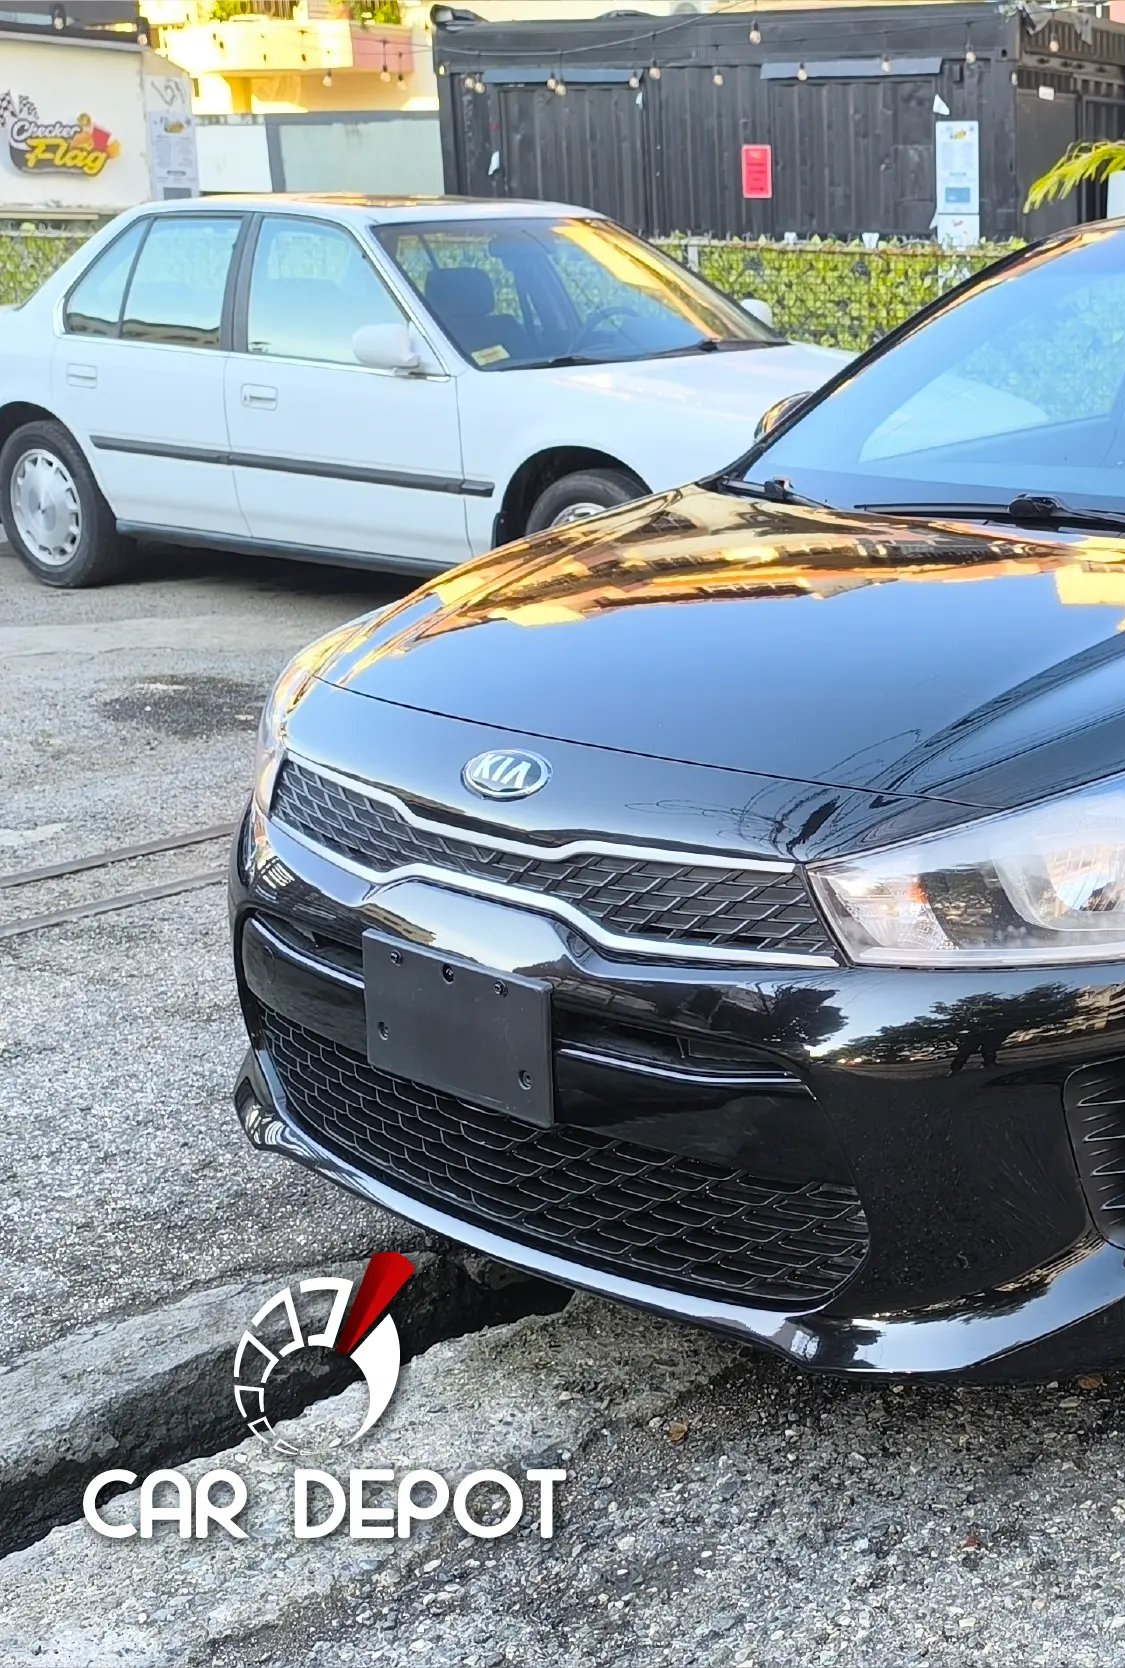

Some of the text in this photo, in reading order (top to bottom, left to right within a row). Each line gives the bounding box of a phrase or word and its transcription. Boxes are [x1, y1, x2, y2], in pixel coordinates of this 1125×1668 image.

[12, 120, 82, 142] Checker
[25, 137, 107, 175] Flag
[473, 753, 531, 788] KIA
